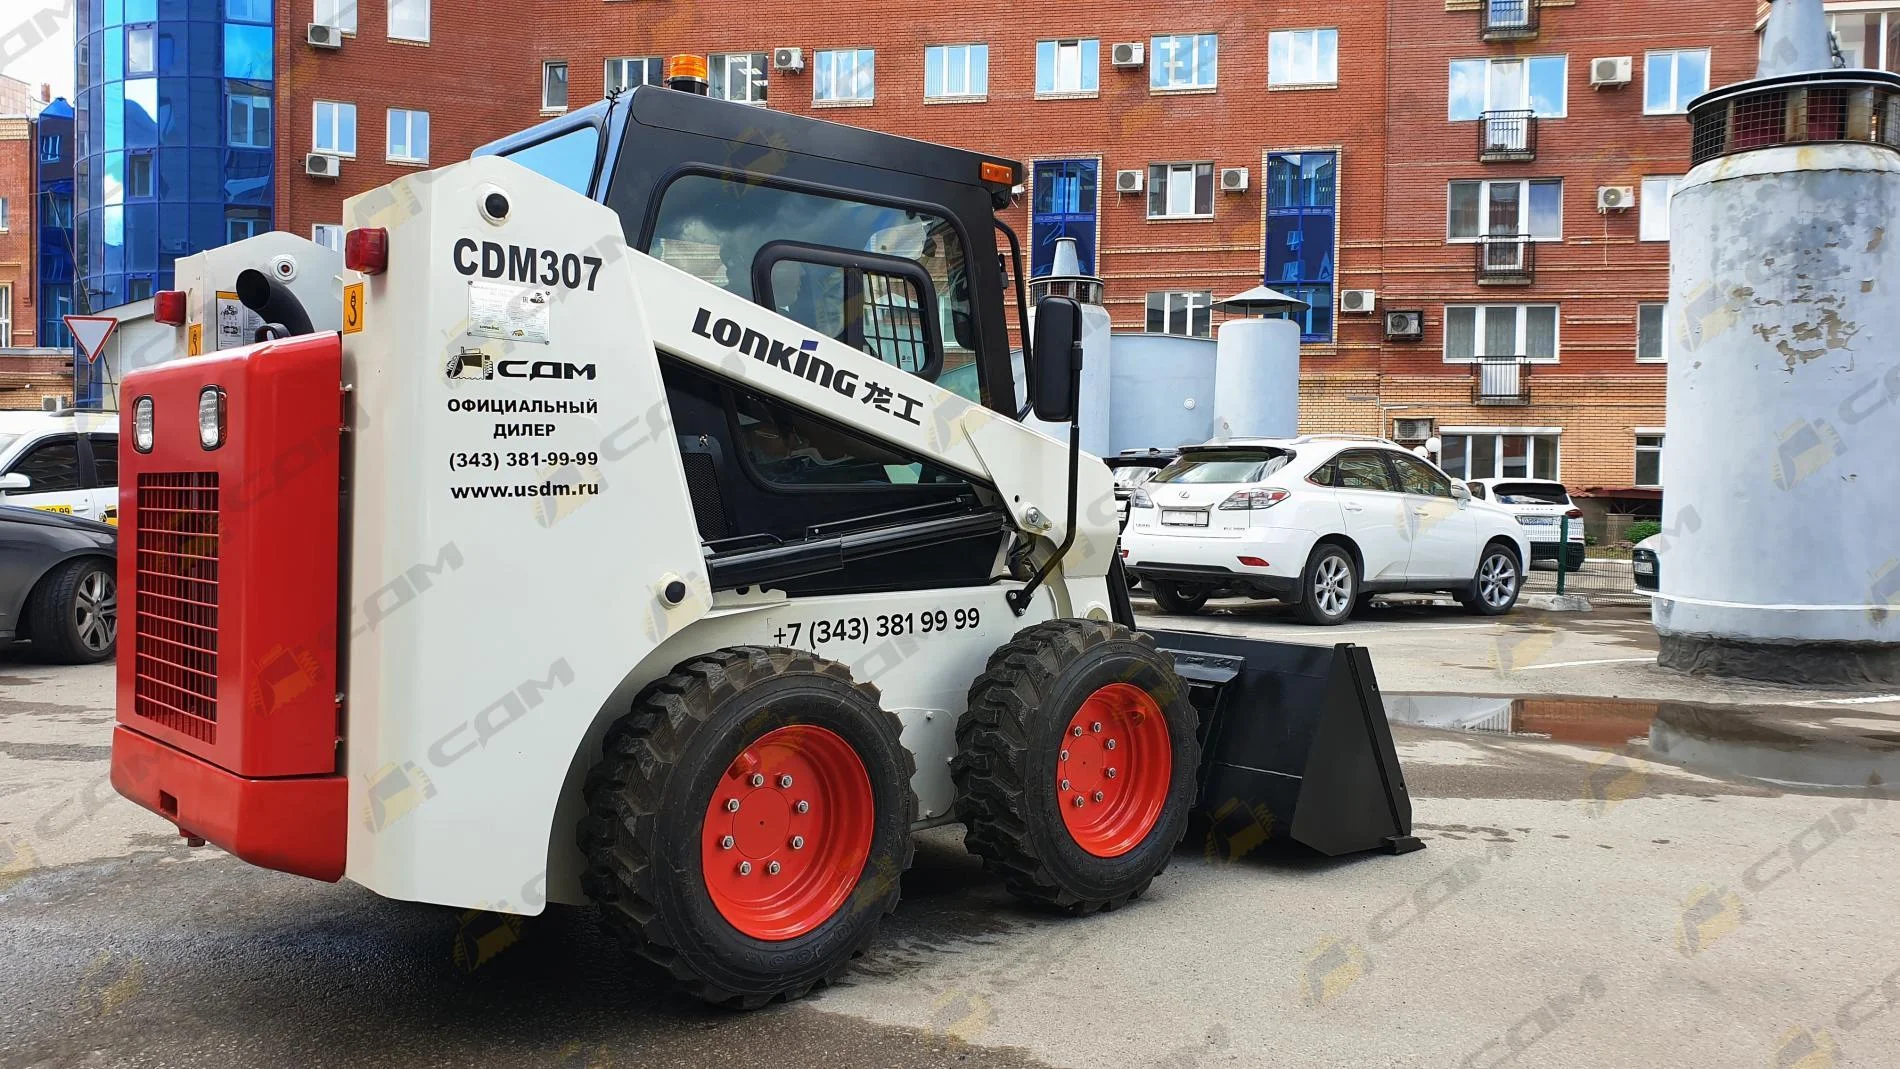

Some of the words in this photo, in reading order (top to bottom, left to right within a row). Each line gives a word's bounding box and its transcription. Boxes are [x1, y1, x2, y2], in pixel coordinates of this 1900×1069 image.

[453, 237, 603, 292] CDM307
[497, 360, 597, 381] СДМ
[691, 307, 859, 399] LONKING
[860, 381, 924, 426] 龙工
[447, 398, 598, 415] ОФИЦИАЛЬНЫЙ
[493, 423, 556, 439] ДИЛЕР
[449, 452, 500, 472] (343)
[506, 451, 598, 468] 381-99-99
[450, 480, 599, 499] www.usdm.ru
[773, 622, 802, 647] +7
[809, 616, 869, 650] (343)
[876, 613, 913, 638] 381
[921, 610, 948, 633] 99
[954, 607, 980, 630] 99
